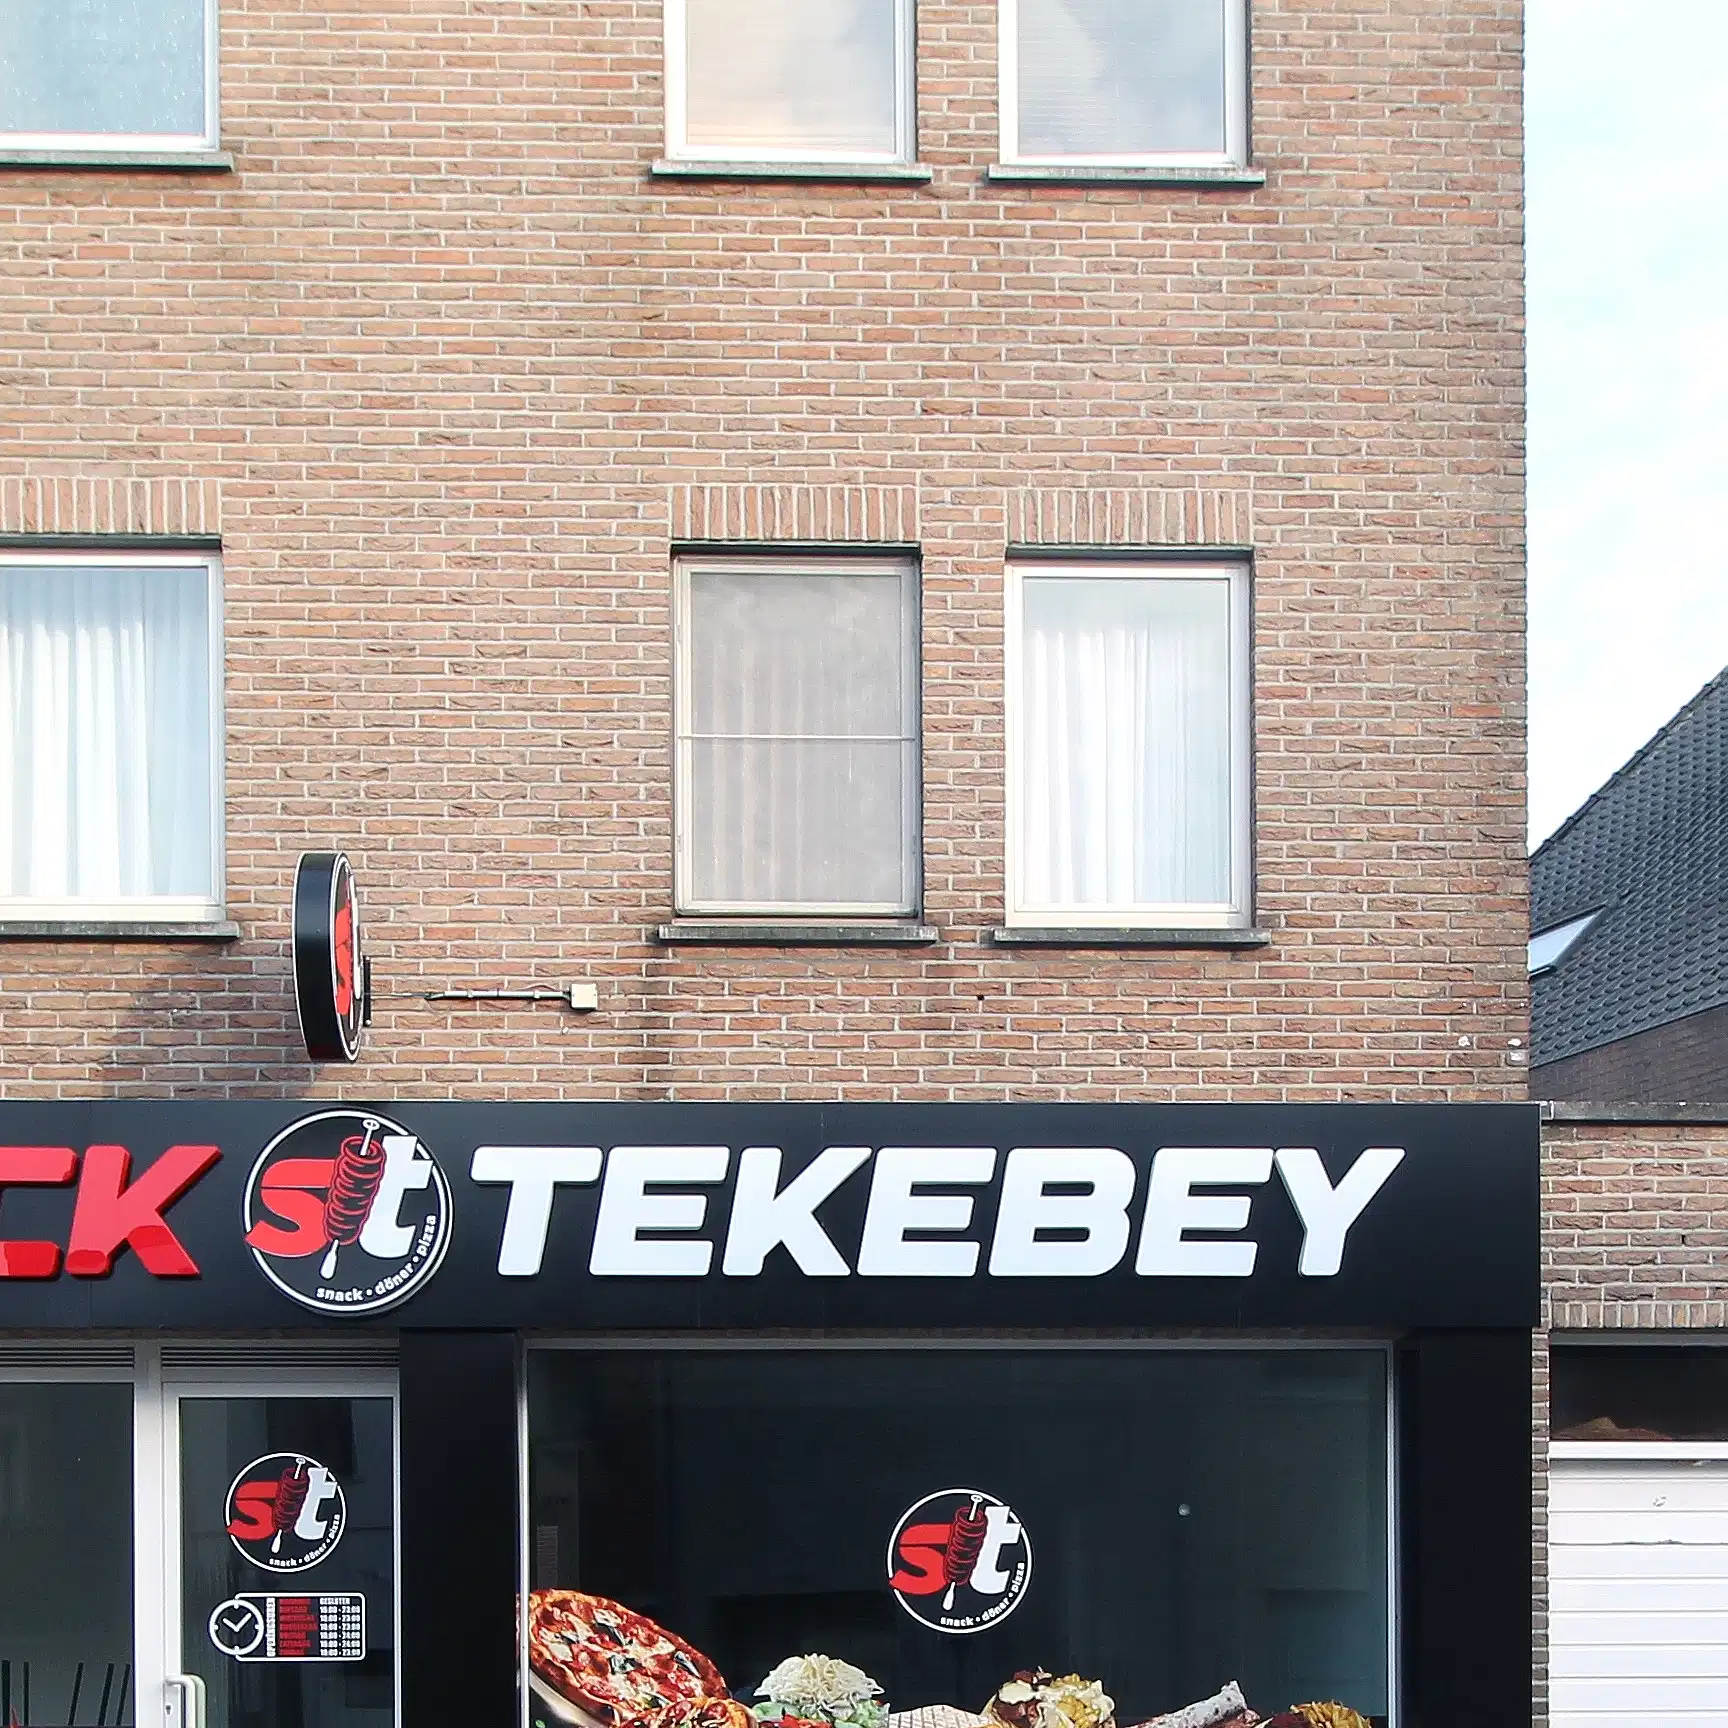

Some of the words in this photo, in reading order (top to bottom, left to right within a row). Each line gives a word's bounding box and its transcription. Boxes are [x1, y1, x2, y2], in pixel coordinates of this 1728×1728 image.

[316, 1286, 364, 1302] snack
[374, 1260, 415, 1296] döner
[416, 1213, 437, 1257] pizza
[469, 1145, 1407, 1278] TEKEBEY
